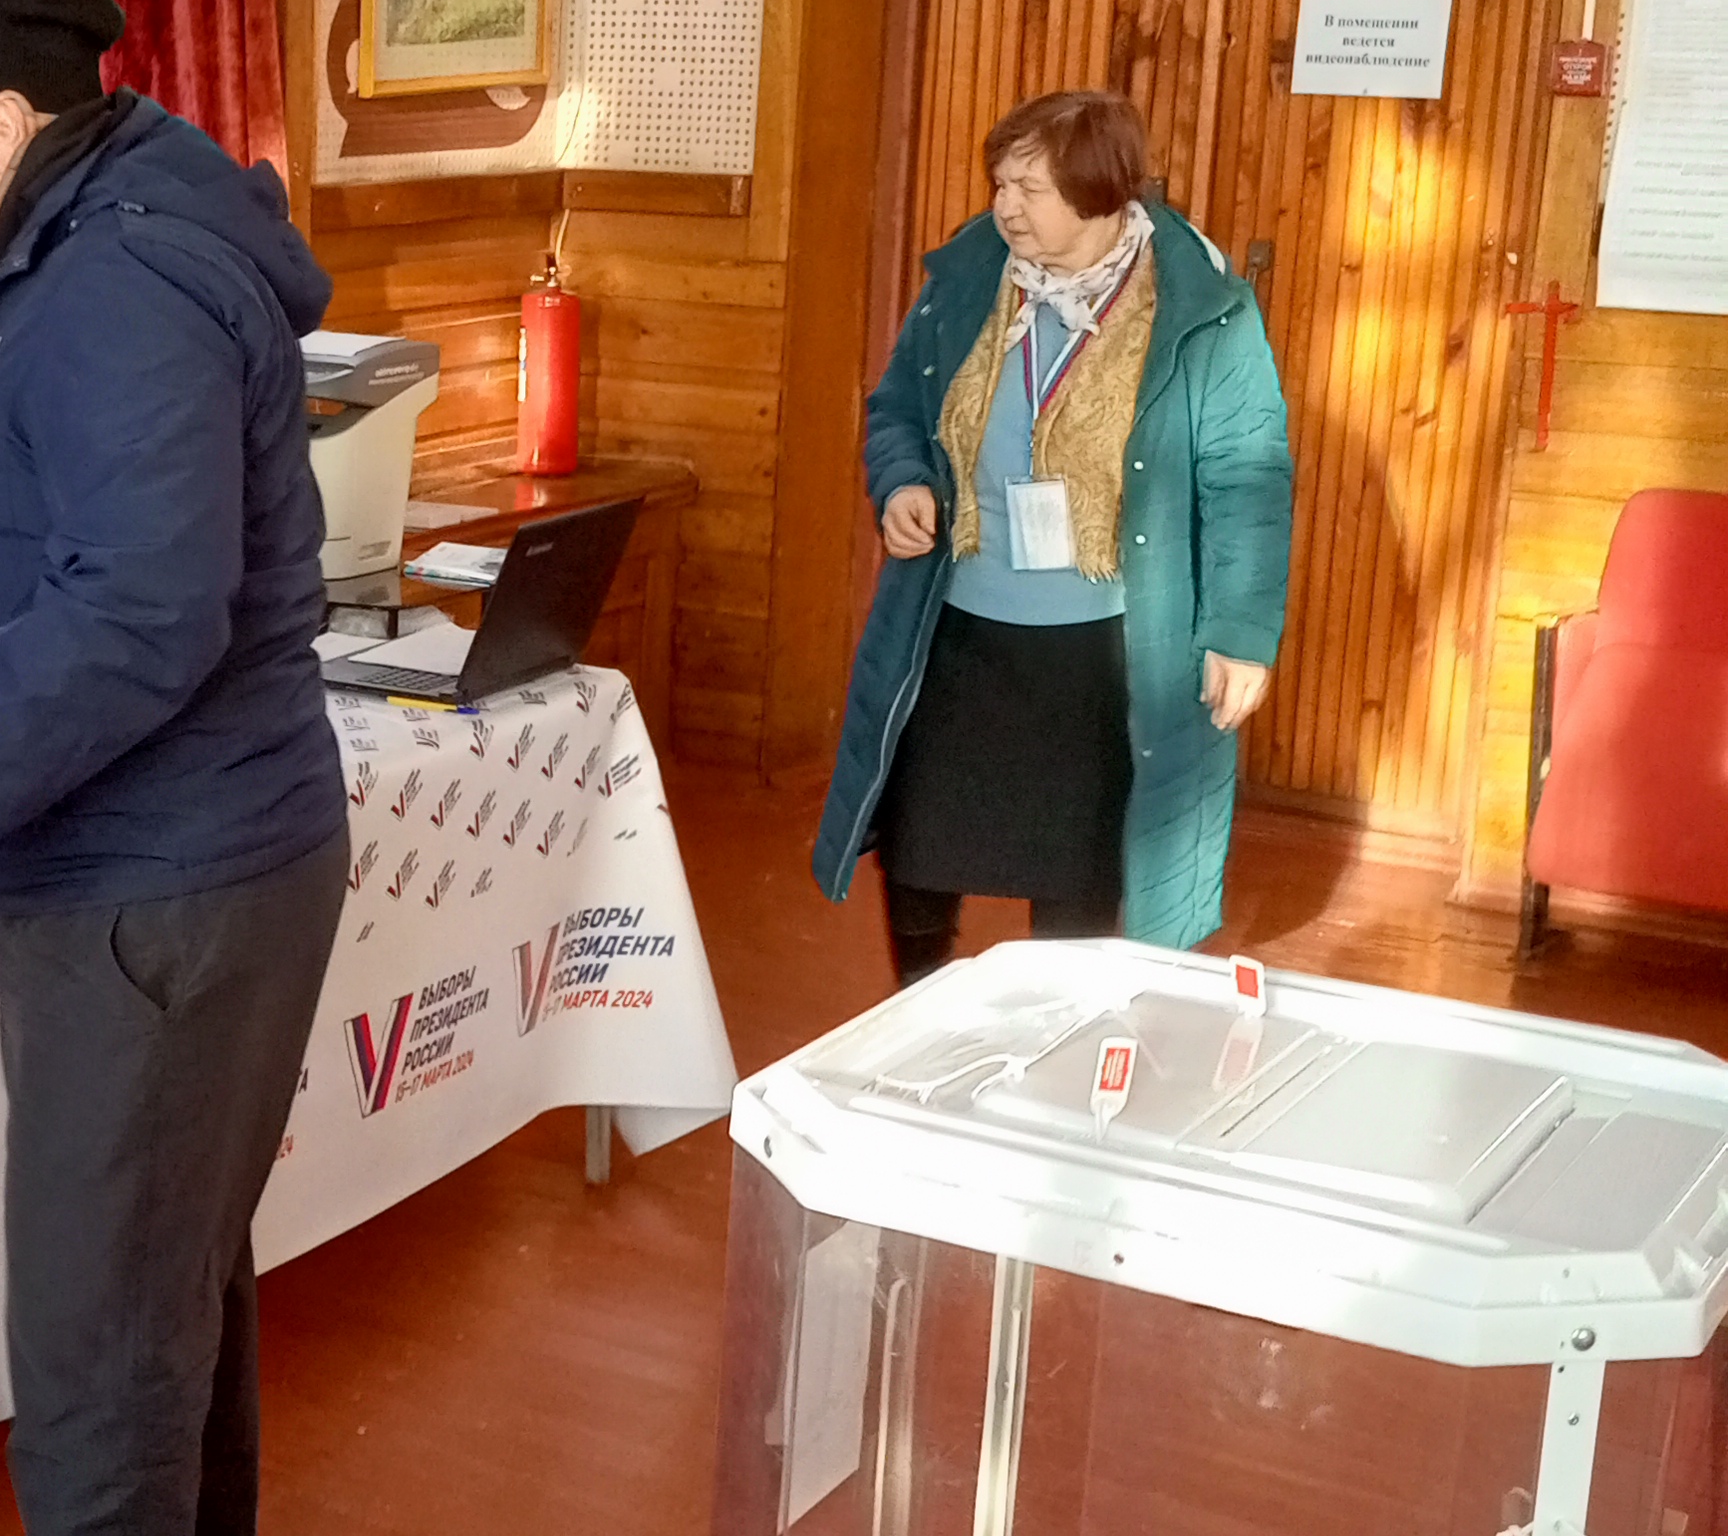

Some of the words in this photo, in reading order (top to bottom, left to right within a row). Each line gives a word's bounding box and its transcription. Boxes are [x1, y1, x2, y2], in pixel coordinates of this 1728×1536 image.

[1324, 15, 1334, 27] В
[1338, 18, 1419, 29] помещении
[1342, 36, 1395, 47] ведется
[1305, 53, 1430, 67] видеонаблюдение
[563, 906, 645, 938] ВЫБОРЫ
[556, 935, 675, 966] ПРЕЗИДЕНТА
[418, 965, 476, 1011] ВЫБОРЫ
[562, 990, 609, 1010] МАРТА
[611, 990, 653, 1008] 2024
[409, 988, 490, 1043] ПРЕЗИДЕНТА
[401, 1031, 455, 1075] РОССИИ
[420, 1058, 453, 1091] МАРТА
[452, 1048, 474, 1076] 2024
